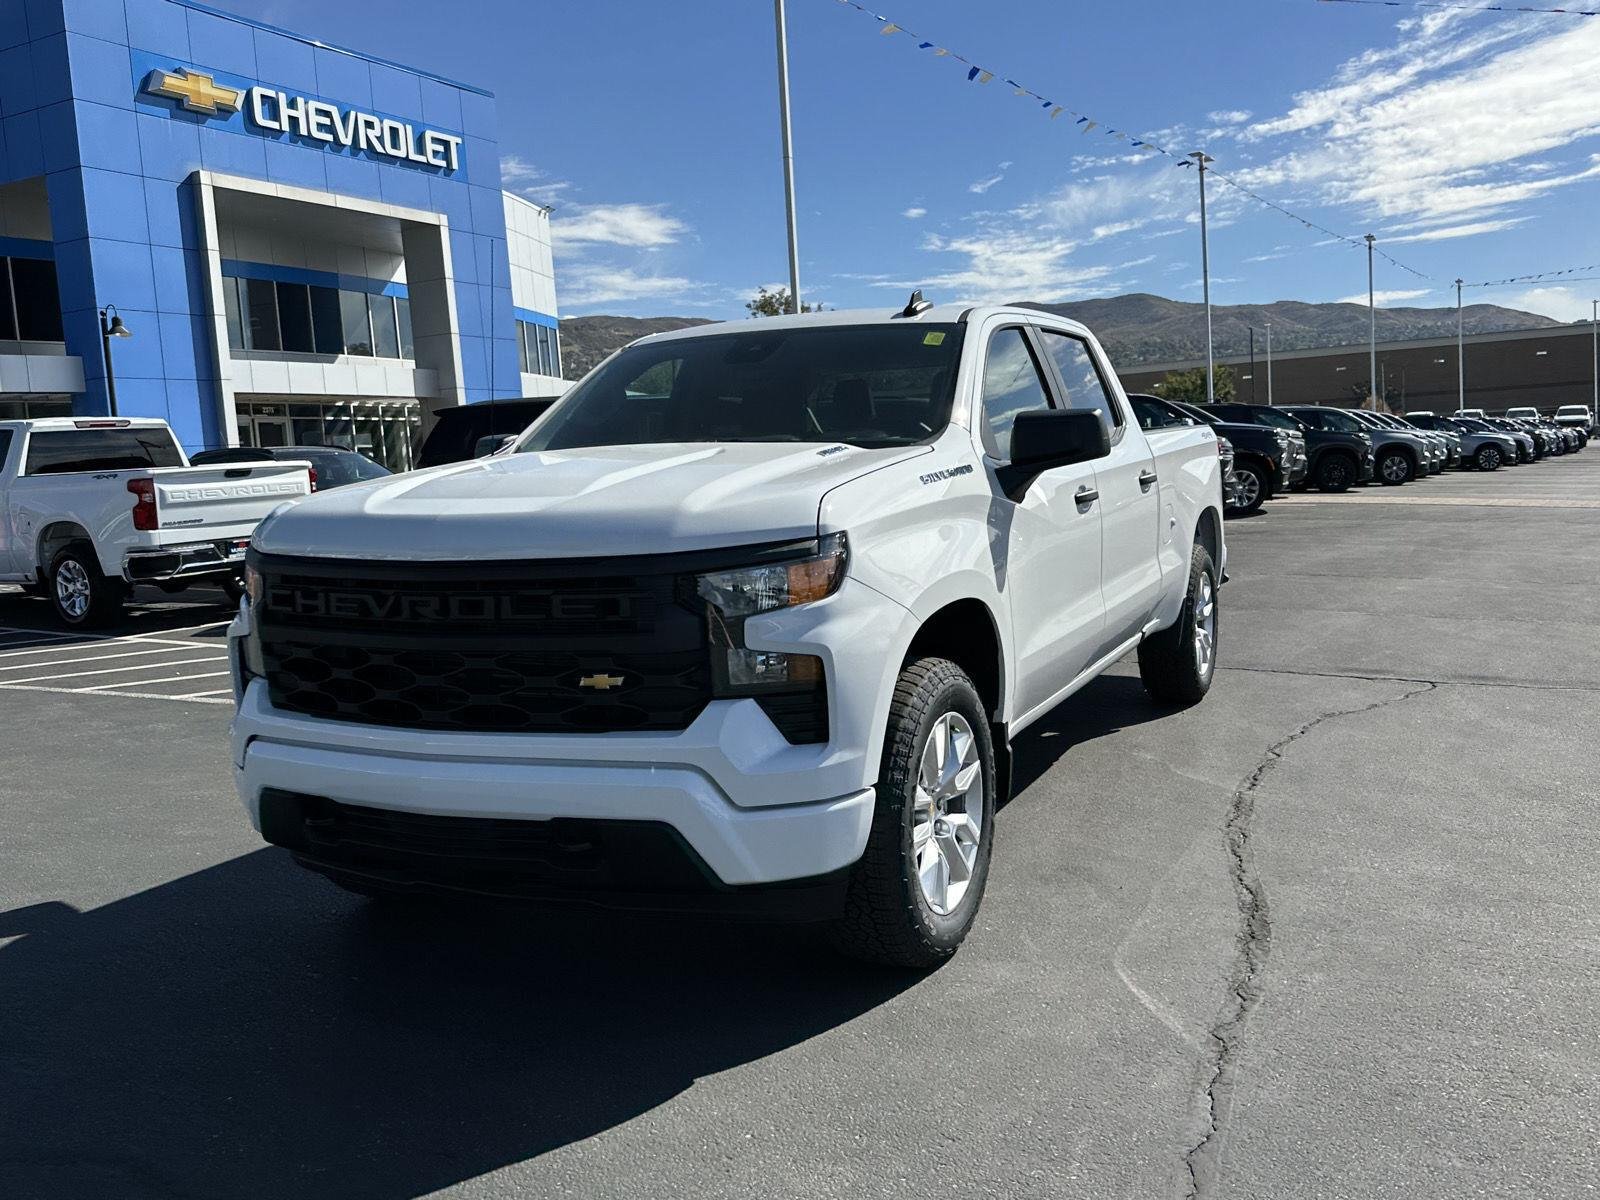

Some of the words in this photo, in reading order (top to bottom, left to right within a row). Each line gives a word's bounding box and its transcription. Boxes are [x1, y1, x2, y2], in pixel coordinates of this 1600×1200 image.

[252, 86, 463, 170] CHEVROLET
[168, 482, 305, 502] CHEVROLET
[267, 587, 643, 621] CHEVROLET
